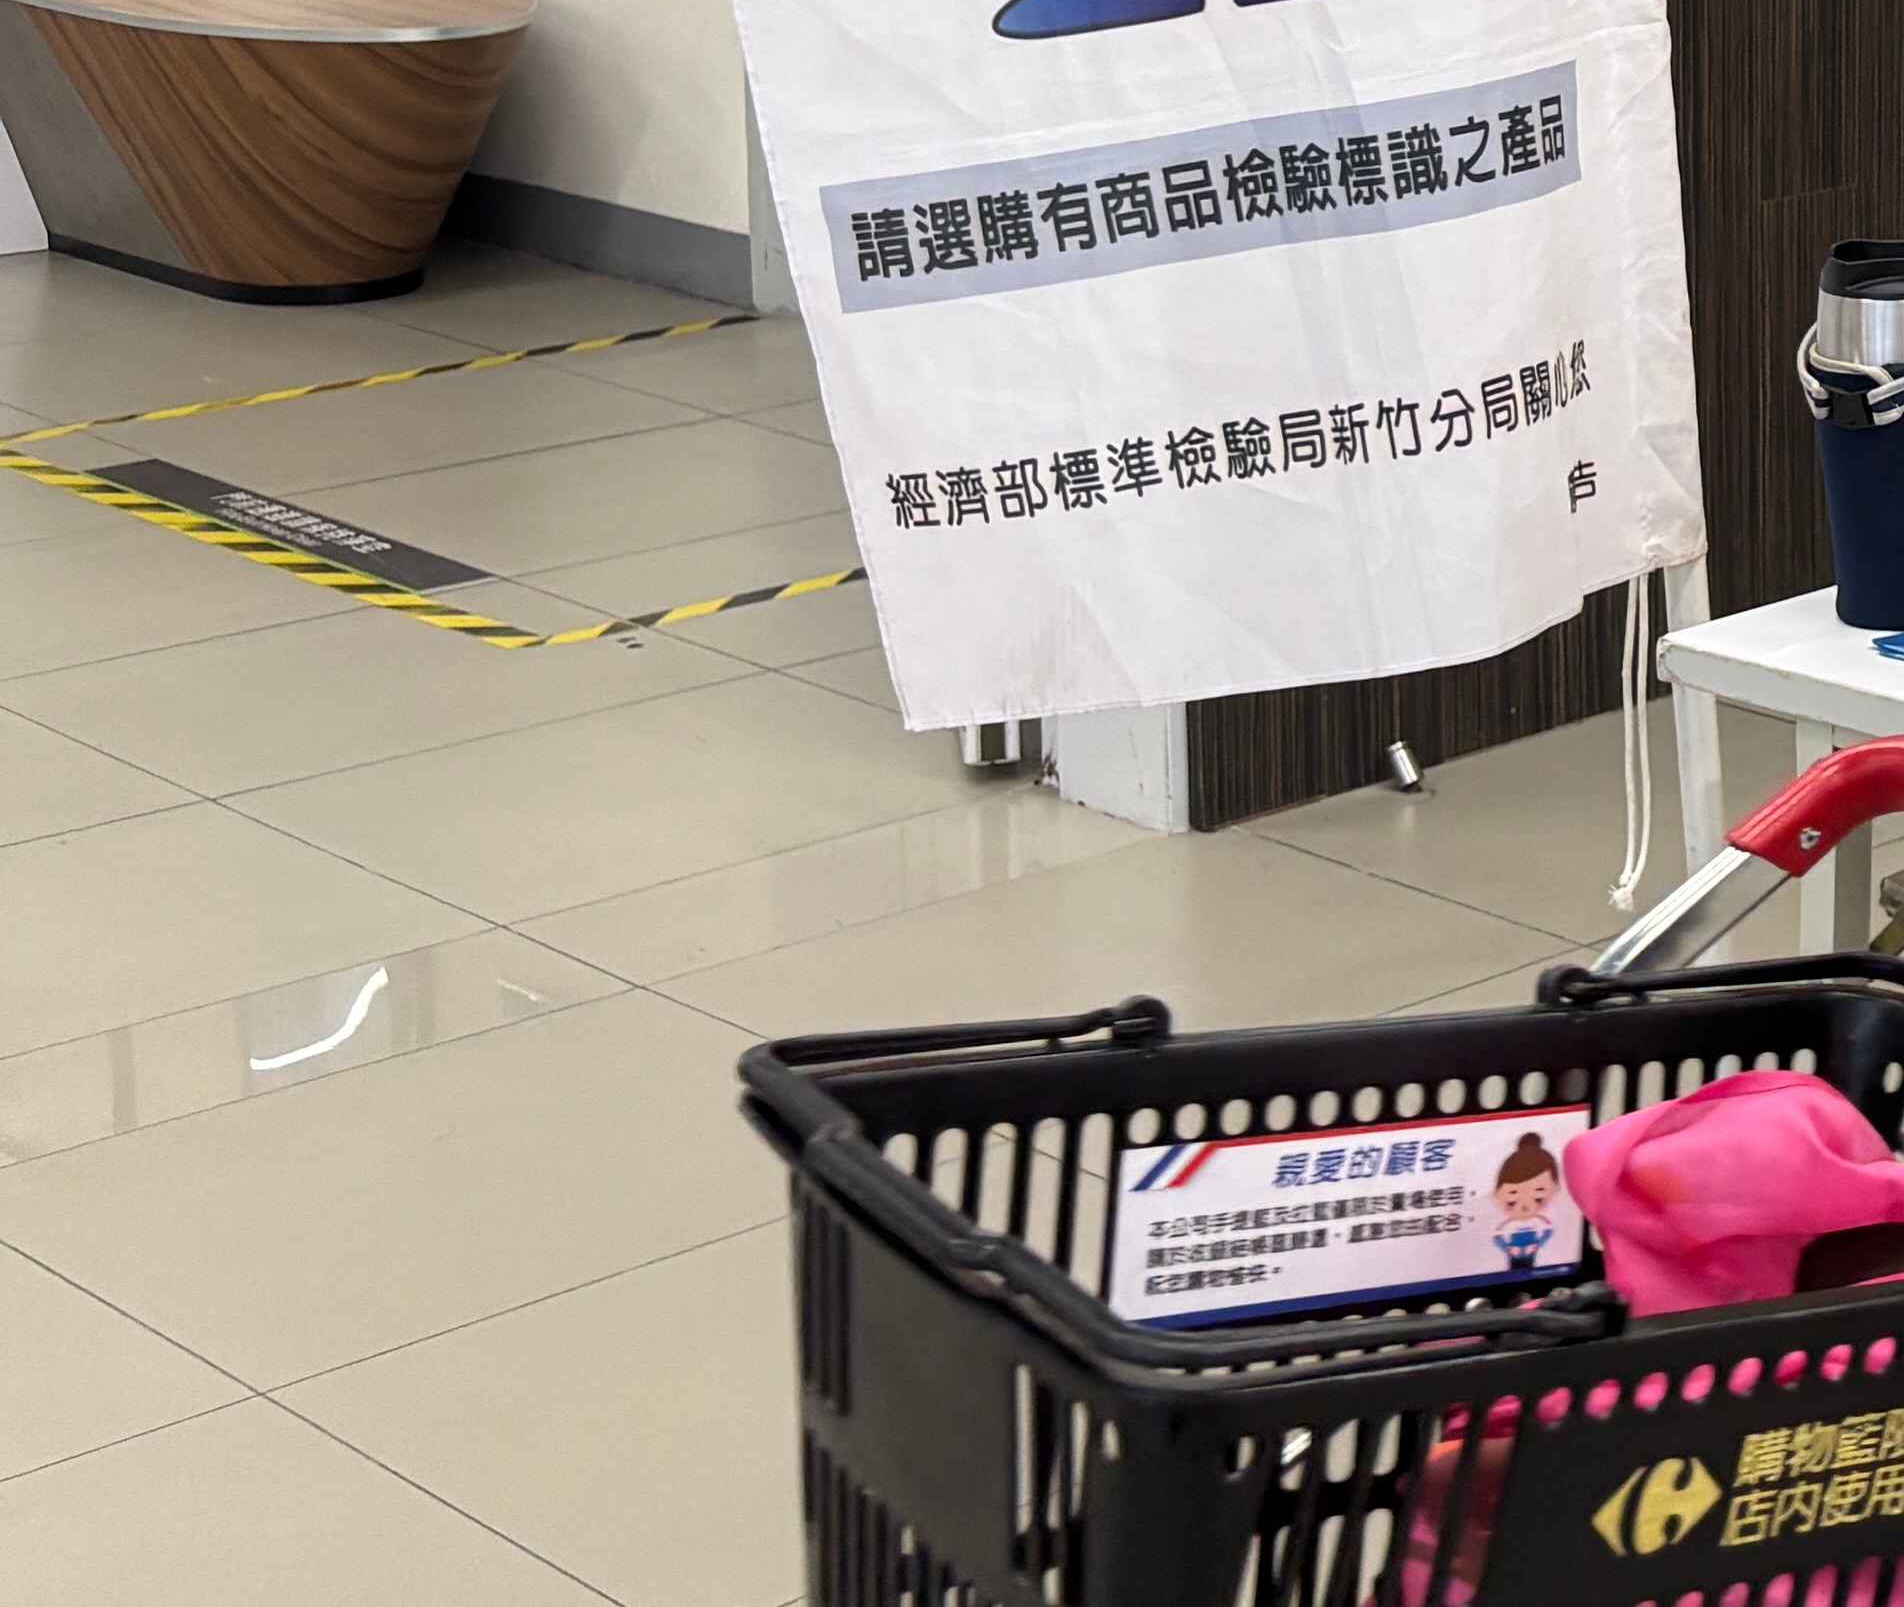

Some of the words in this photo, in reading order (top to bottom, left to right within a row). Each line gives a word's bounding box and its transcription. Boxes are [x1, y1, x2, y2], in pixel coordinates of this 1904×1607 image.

[851, 93, 1566, 282] 請選購有商品檢驗標識之產品
[1271, 1139, 1456, 1188] 親愛的顧客
